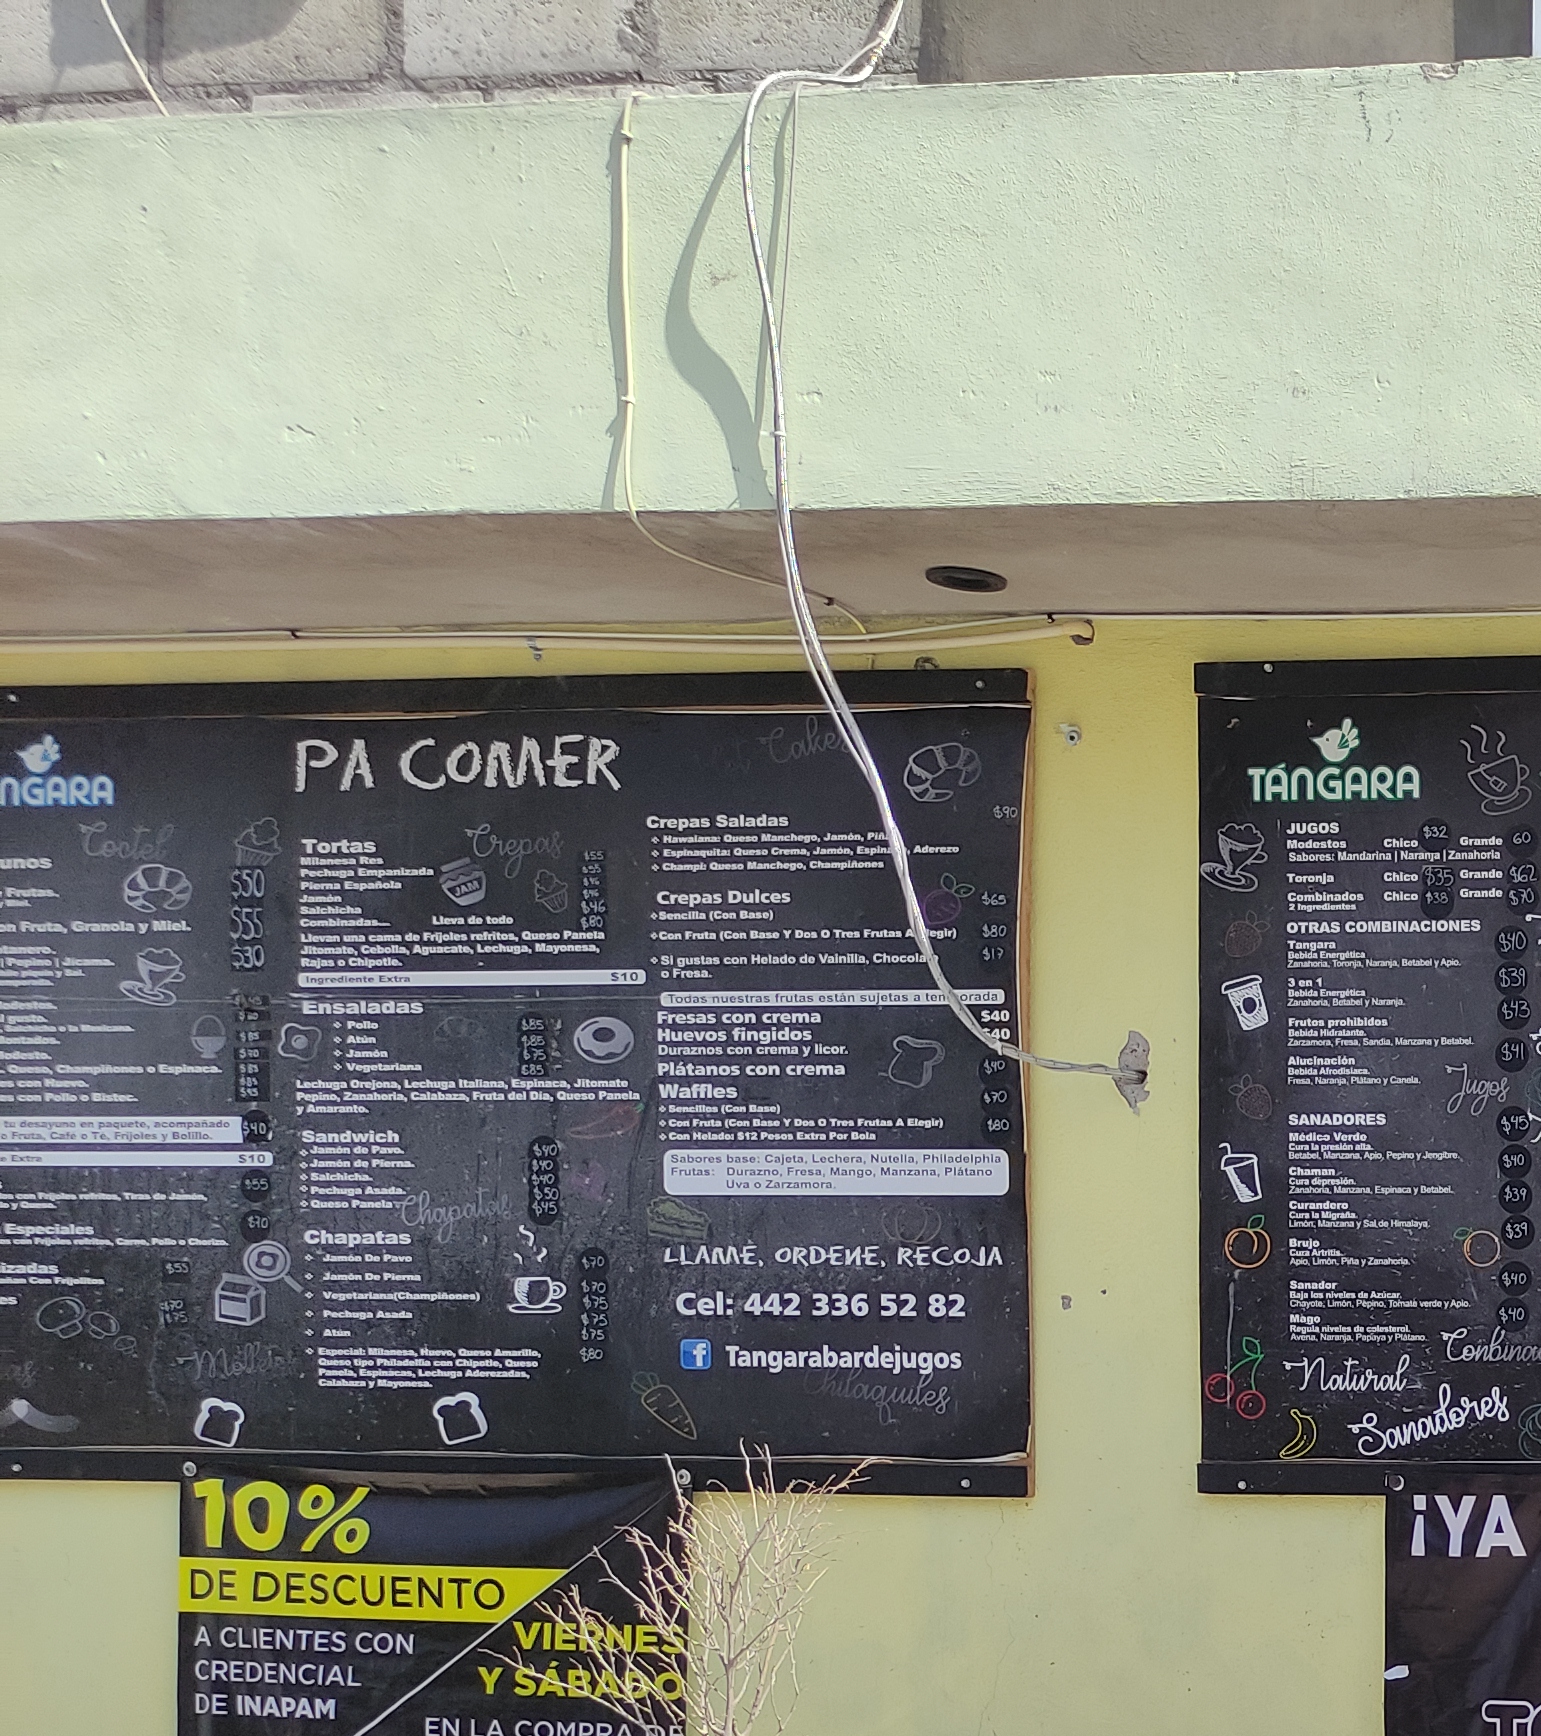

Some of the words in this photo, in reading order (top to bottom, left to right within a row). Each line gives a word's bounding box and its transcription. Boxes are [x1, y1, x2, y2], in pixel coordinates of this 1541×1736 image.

[294, 738, 375, 793] PA
[398, 734, 622, 791] COMER
[0, 775, 114, 806] NGARA
[1247, 763, 1421, 802] TÁNGARA
[646, 815, 711, 832] Crepas
[715, 813, 789, 828] Saladas
[1286, 821, 1340, 835] JUGOS
[300, 838, 377, 854] Tortas
[452, 881, 482, 898] JAM
[656, 890, 723, 908] Crepas
[727, 888, 791, 904] Dulces
[1286, 921, 1341, 934] OTRAS
[1344, 919, 1481, 933] COMBINACIONES
[305, 975, 375, 986] Ingrediente
[378, 974, 411, 983] Extra
[301, 1000, 426, 1015] Ensaladas
[980, 1008, 1010, 1024] $40
[656, 1010, 717, 1025] Fresas
[721, 1012, 757, 1024] con
[761, 1012, 822, 1024] crema
[657, 1027, 728, 1042] Huevos
[732, 1027, 812, 1045] fingidos
[657, 1061, 741, 1077] Plátanos
[745, 1064, 781, 1076] con
[785, 1064, 846, 1076] crema
[658, 1083, 738, 1099] Waffles
[1288, 1113, 1387, 1126] SANADORES
[302, 1130, 399, 1143] Sandwich
[670, 1154, 722, 1164] Sabores
[726, 1153, 760, 1164] base:
[764, 1153, 808, 1166] Cajeta,
[812, 1153, 867, 1165] Lechera,
[870, 1153, 919, 1165] Nutella,
[922, 1153, 1002, 1166] Philadelphia
[303, 1229, 412, 1248] Chapatas
[663, 1244, 764, 1268] LLAME,
[774, 1245, 886, 1270] ORDENE,
[896, 1245, 1003, 1270] RECOJA
[675, 1290, 734, 1316] Cel:
[738, 1292, 801, 1316] 442
[811, 1292, 869, 1317] 336
[880, 1293, 918, 1317] 52
[928, 1293, 966, 1318] 82
[725, 1343, 962, 1376] Tangarabardejugos
[194, 1478, 371, 1554] 10%
[1410, 1494, 1526, 1558] ¡YA
[190, 1568, 237, 1601] DE
[253, 1571, 506, 1610] DESCUENTO
[195, 1627, 211, 1647] A
[219, 1627, 346, 1652] CLIENTES
[355, 1632, 414, 1654] CON
[195, 1660, 361, 1687] CREDENCIAL
[478, 1667, 503, 1695] Y
[195, 1693, 228, 1715] DE
[236, 1695, 336, 1719] INAPAM
